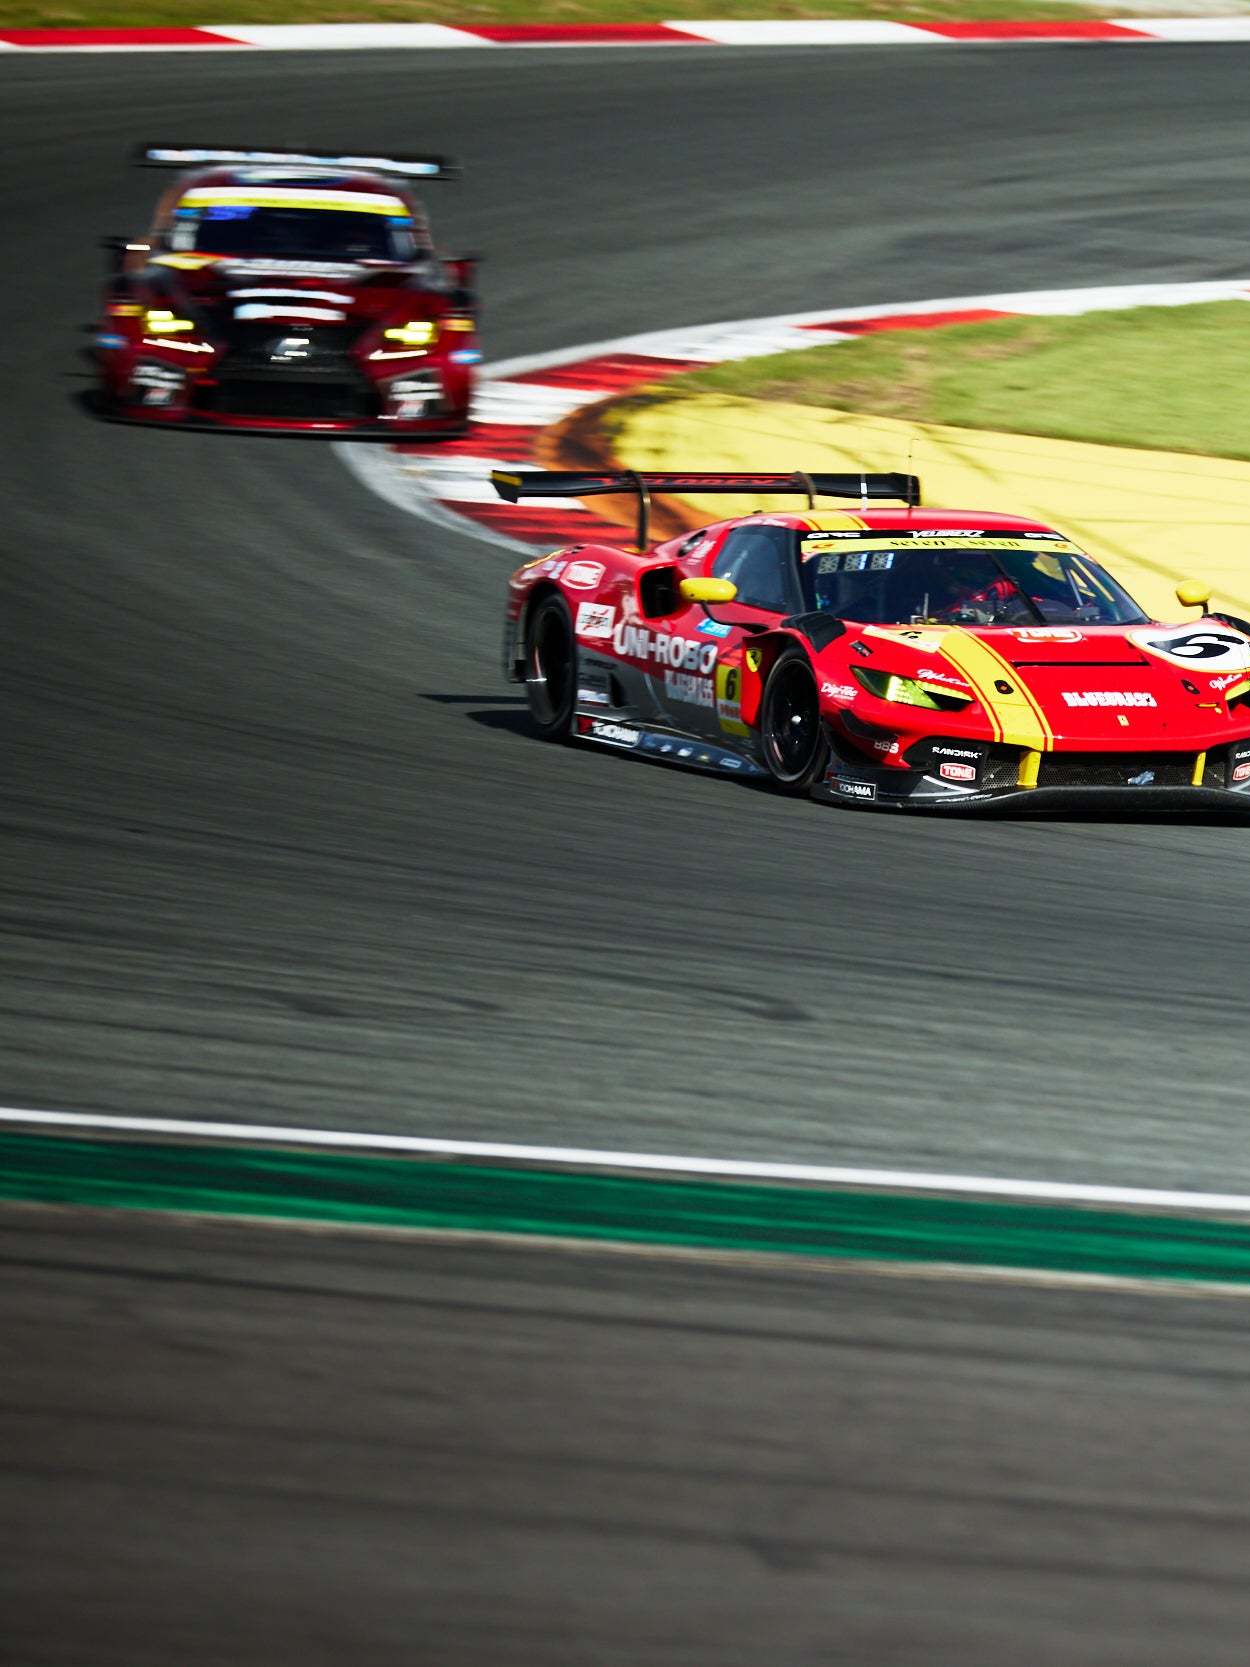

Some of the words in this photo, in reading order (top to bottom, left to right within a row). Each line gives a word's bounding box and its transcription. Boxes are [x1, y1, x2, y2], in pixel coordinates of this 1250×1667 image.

[613, 623, 719, 676] UNI-ROBO
[1147, 632, 1245, 659] 6
[725, 668, 738, 701] 6
[943, 766, 973, 779] TONE
